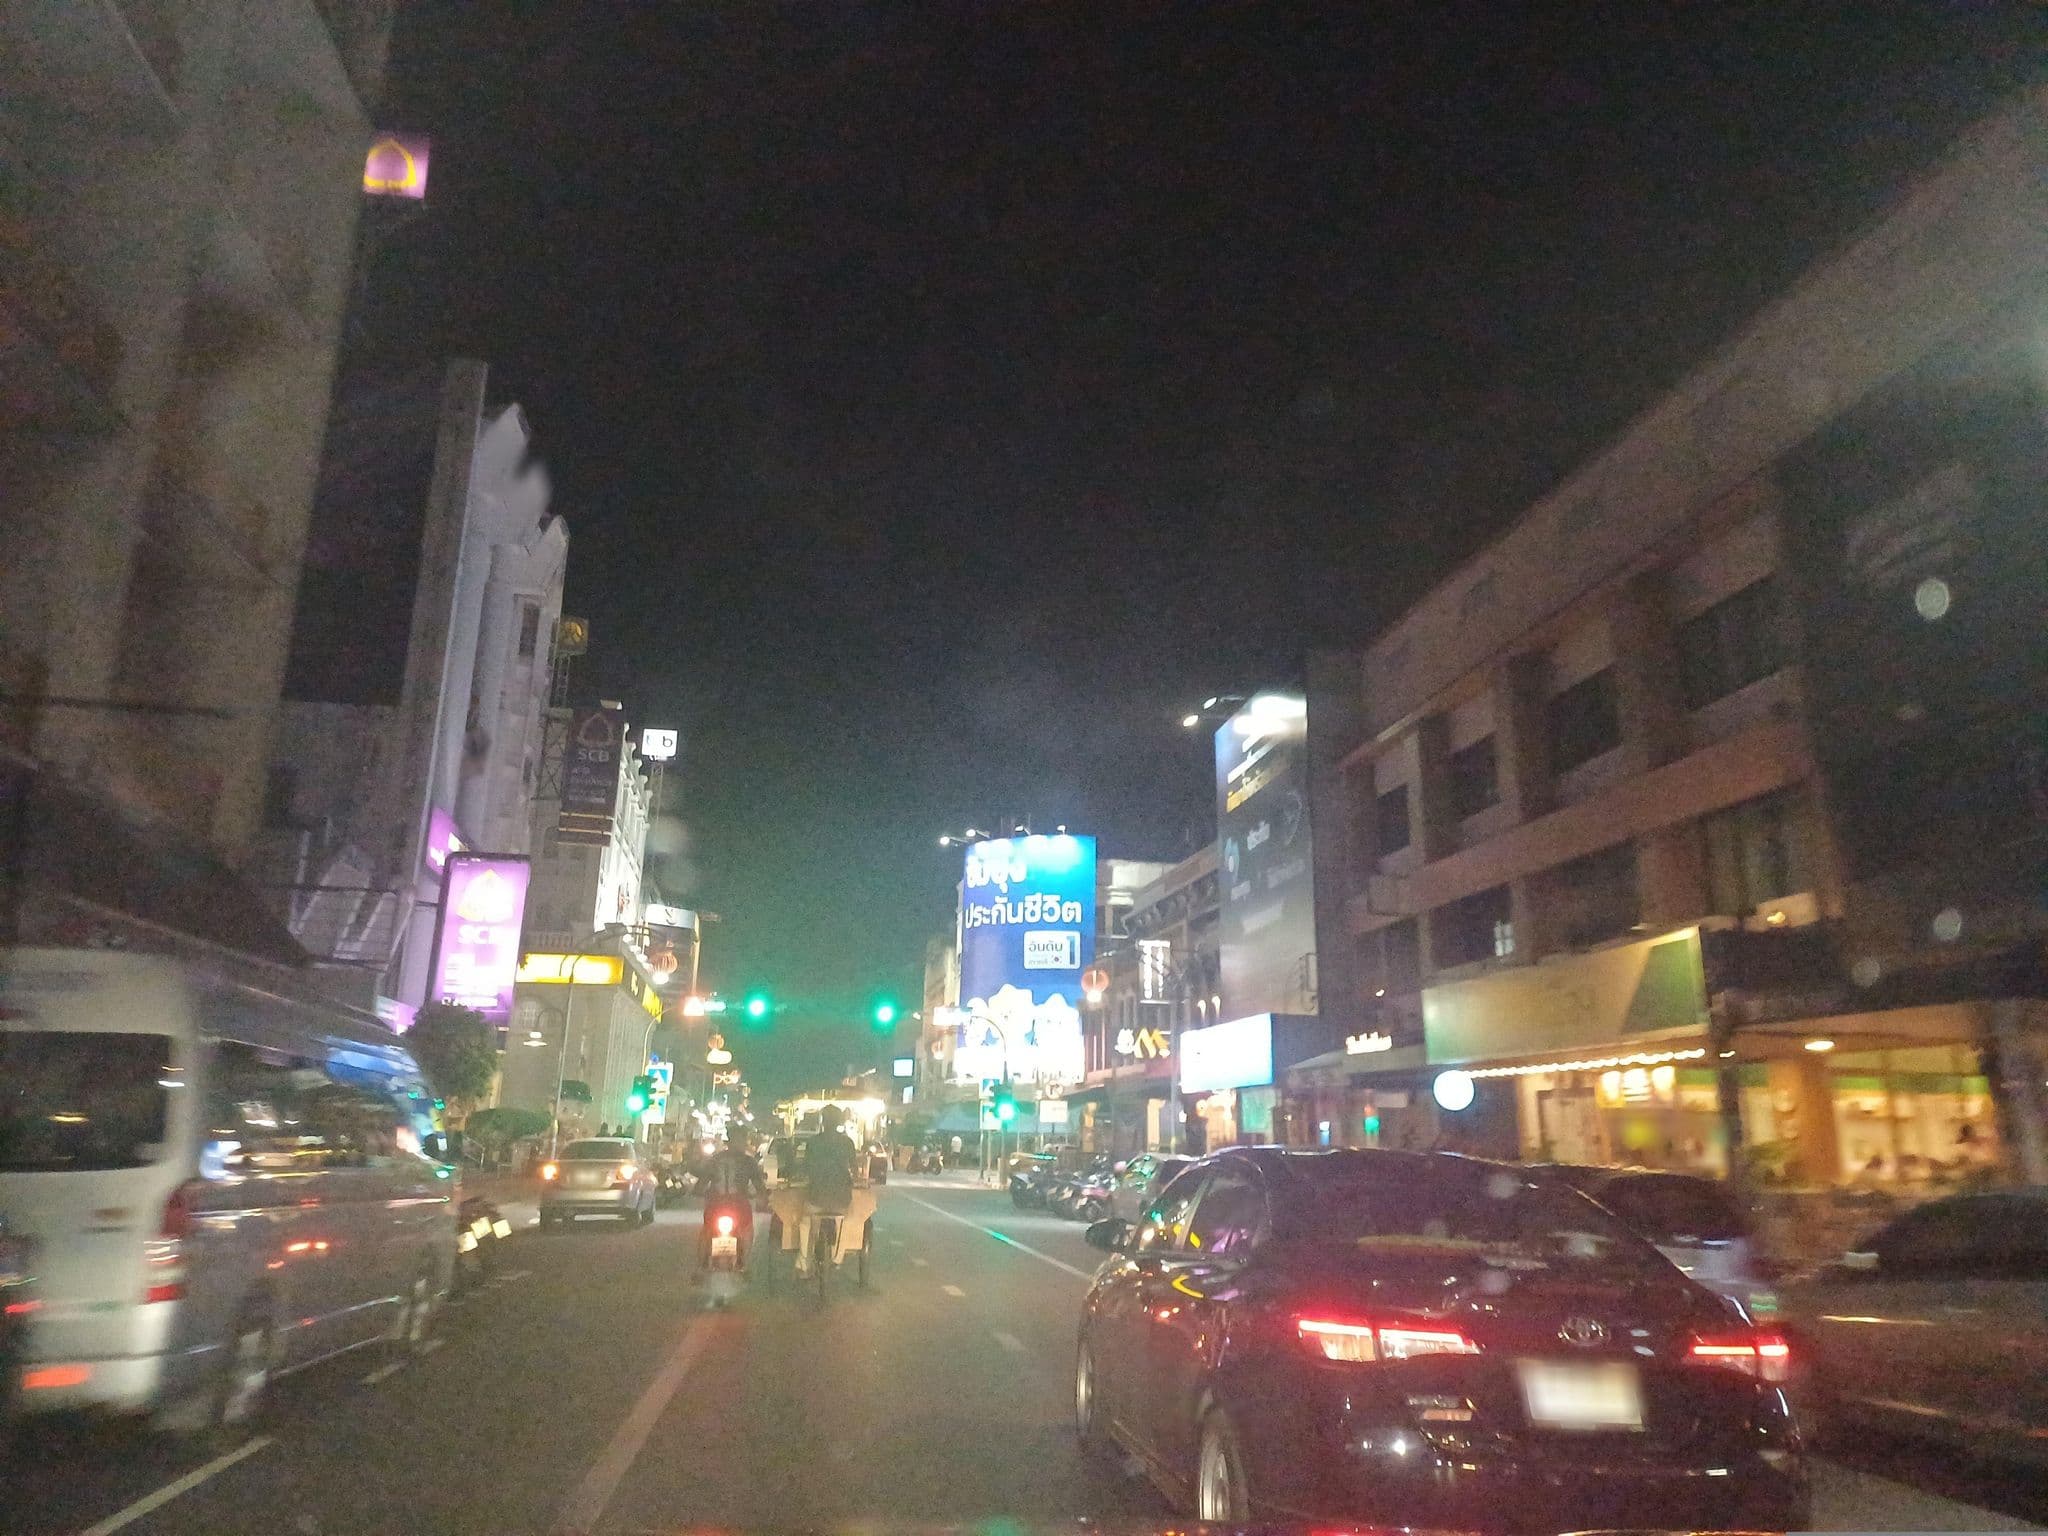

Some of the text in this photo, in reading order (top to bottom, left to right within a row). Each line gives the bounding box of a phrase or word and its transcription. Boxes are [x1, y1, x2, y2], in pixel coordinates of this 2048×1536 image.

[577, 750, 610, 763] SCB
[965, 892, 1083, 929] ประกันชีวิต
[1028, 939, 1063, 953] อันดับ
